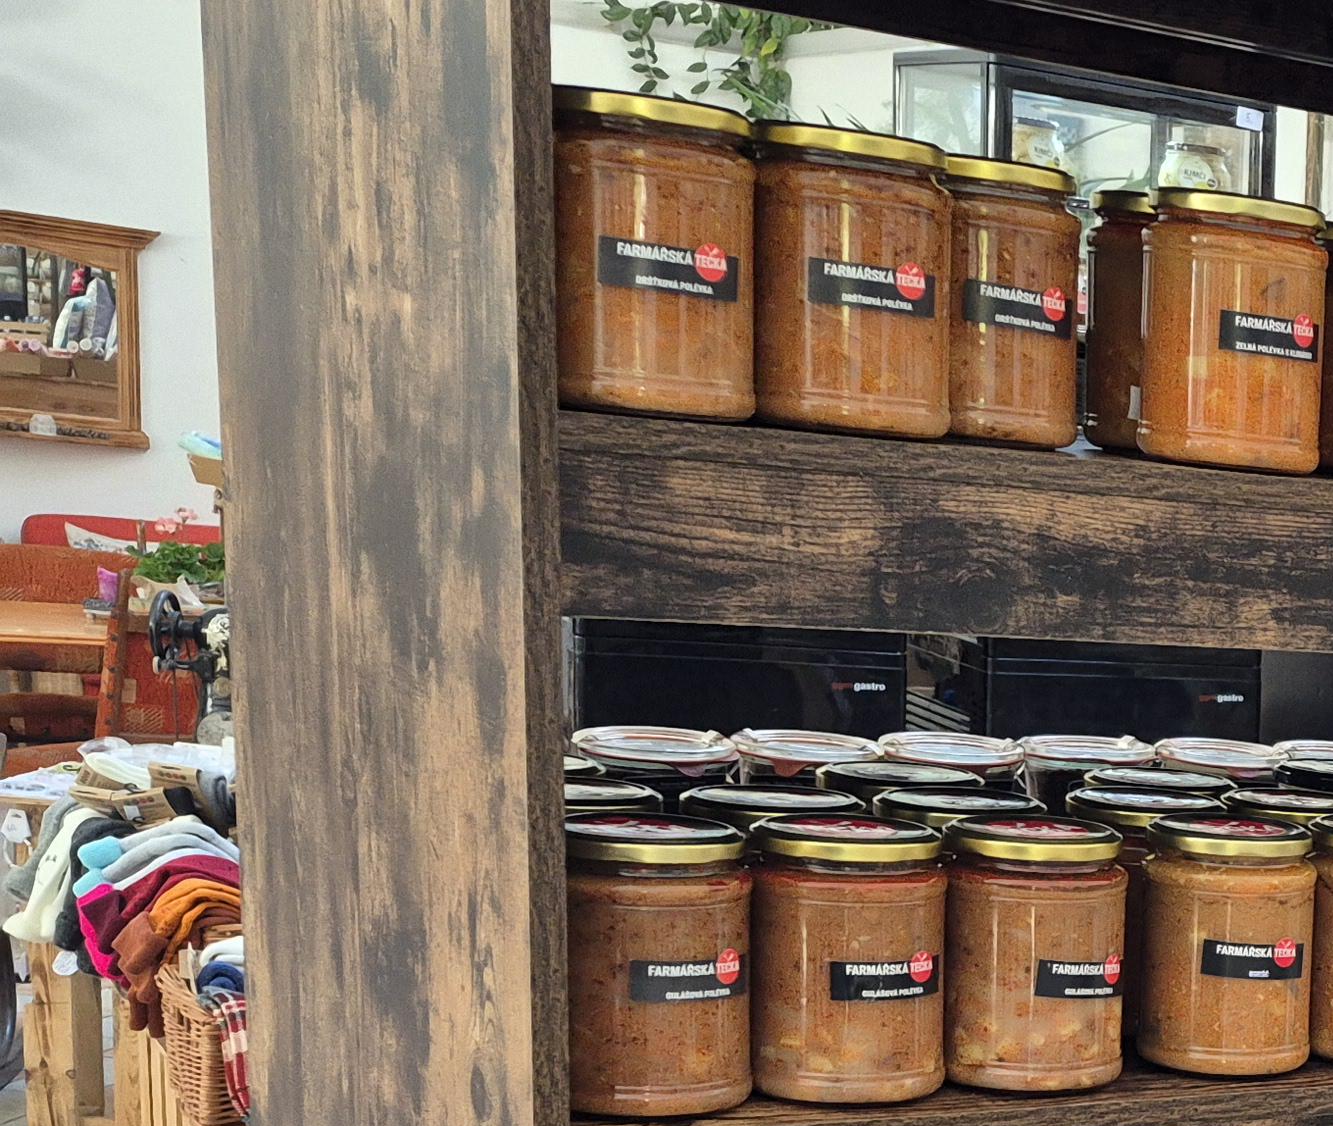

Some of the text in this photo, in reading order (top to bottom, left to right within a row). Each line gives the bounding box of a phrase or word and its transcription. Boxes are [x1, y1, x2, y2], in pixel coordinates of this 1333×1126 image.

[616, 241, 728, 272] FARMÁŘSKÁ TEČKA
[823, 262, 894, 284] FARMÁŘSKÁ
[979, 284, 1042, 307] FARMÁŘSKÁ
[1235, 315, 1292, 335] FARMÁŘSKÁ
[1216, 944, 1273, 958] FARMÁŘSKÁ
[648, 963, 715, 978] FARMÁŘSKÁ
[845, 962, 909, 976] FARMÁŘSKÁ
[1052, 963, 1104, 977] FARMÁŘSKÁ
